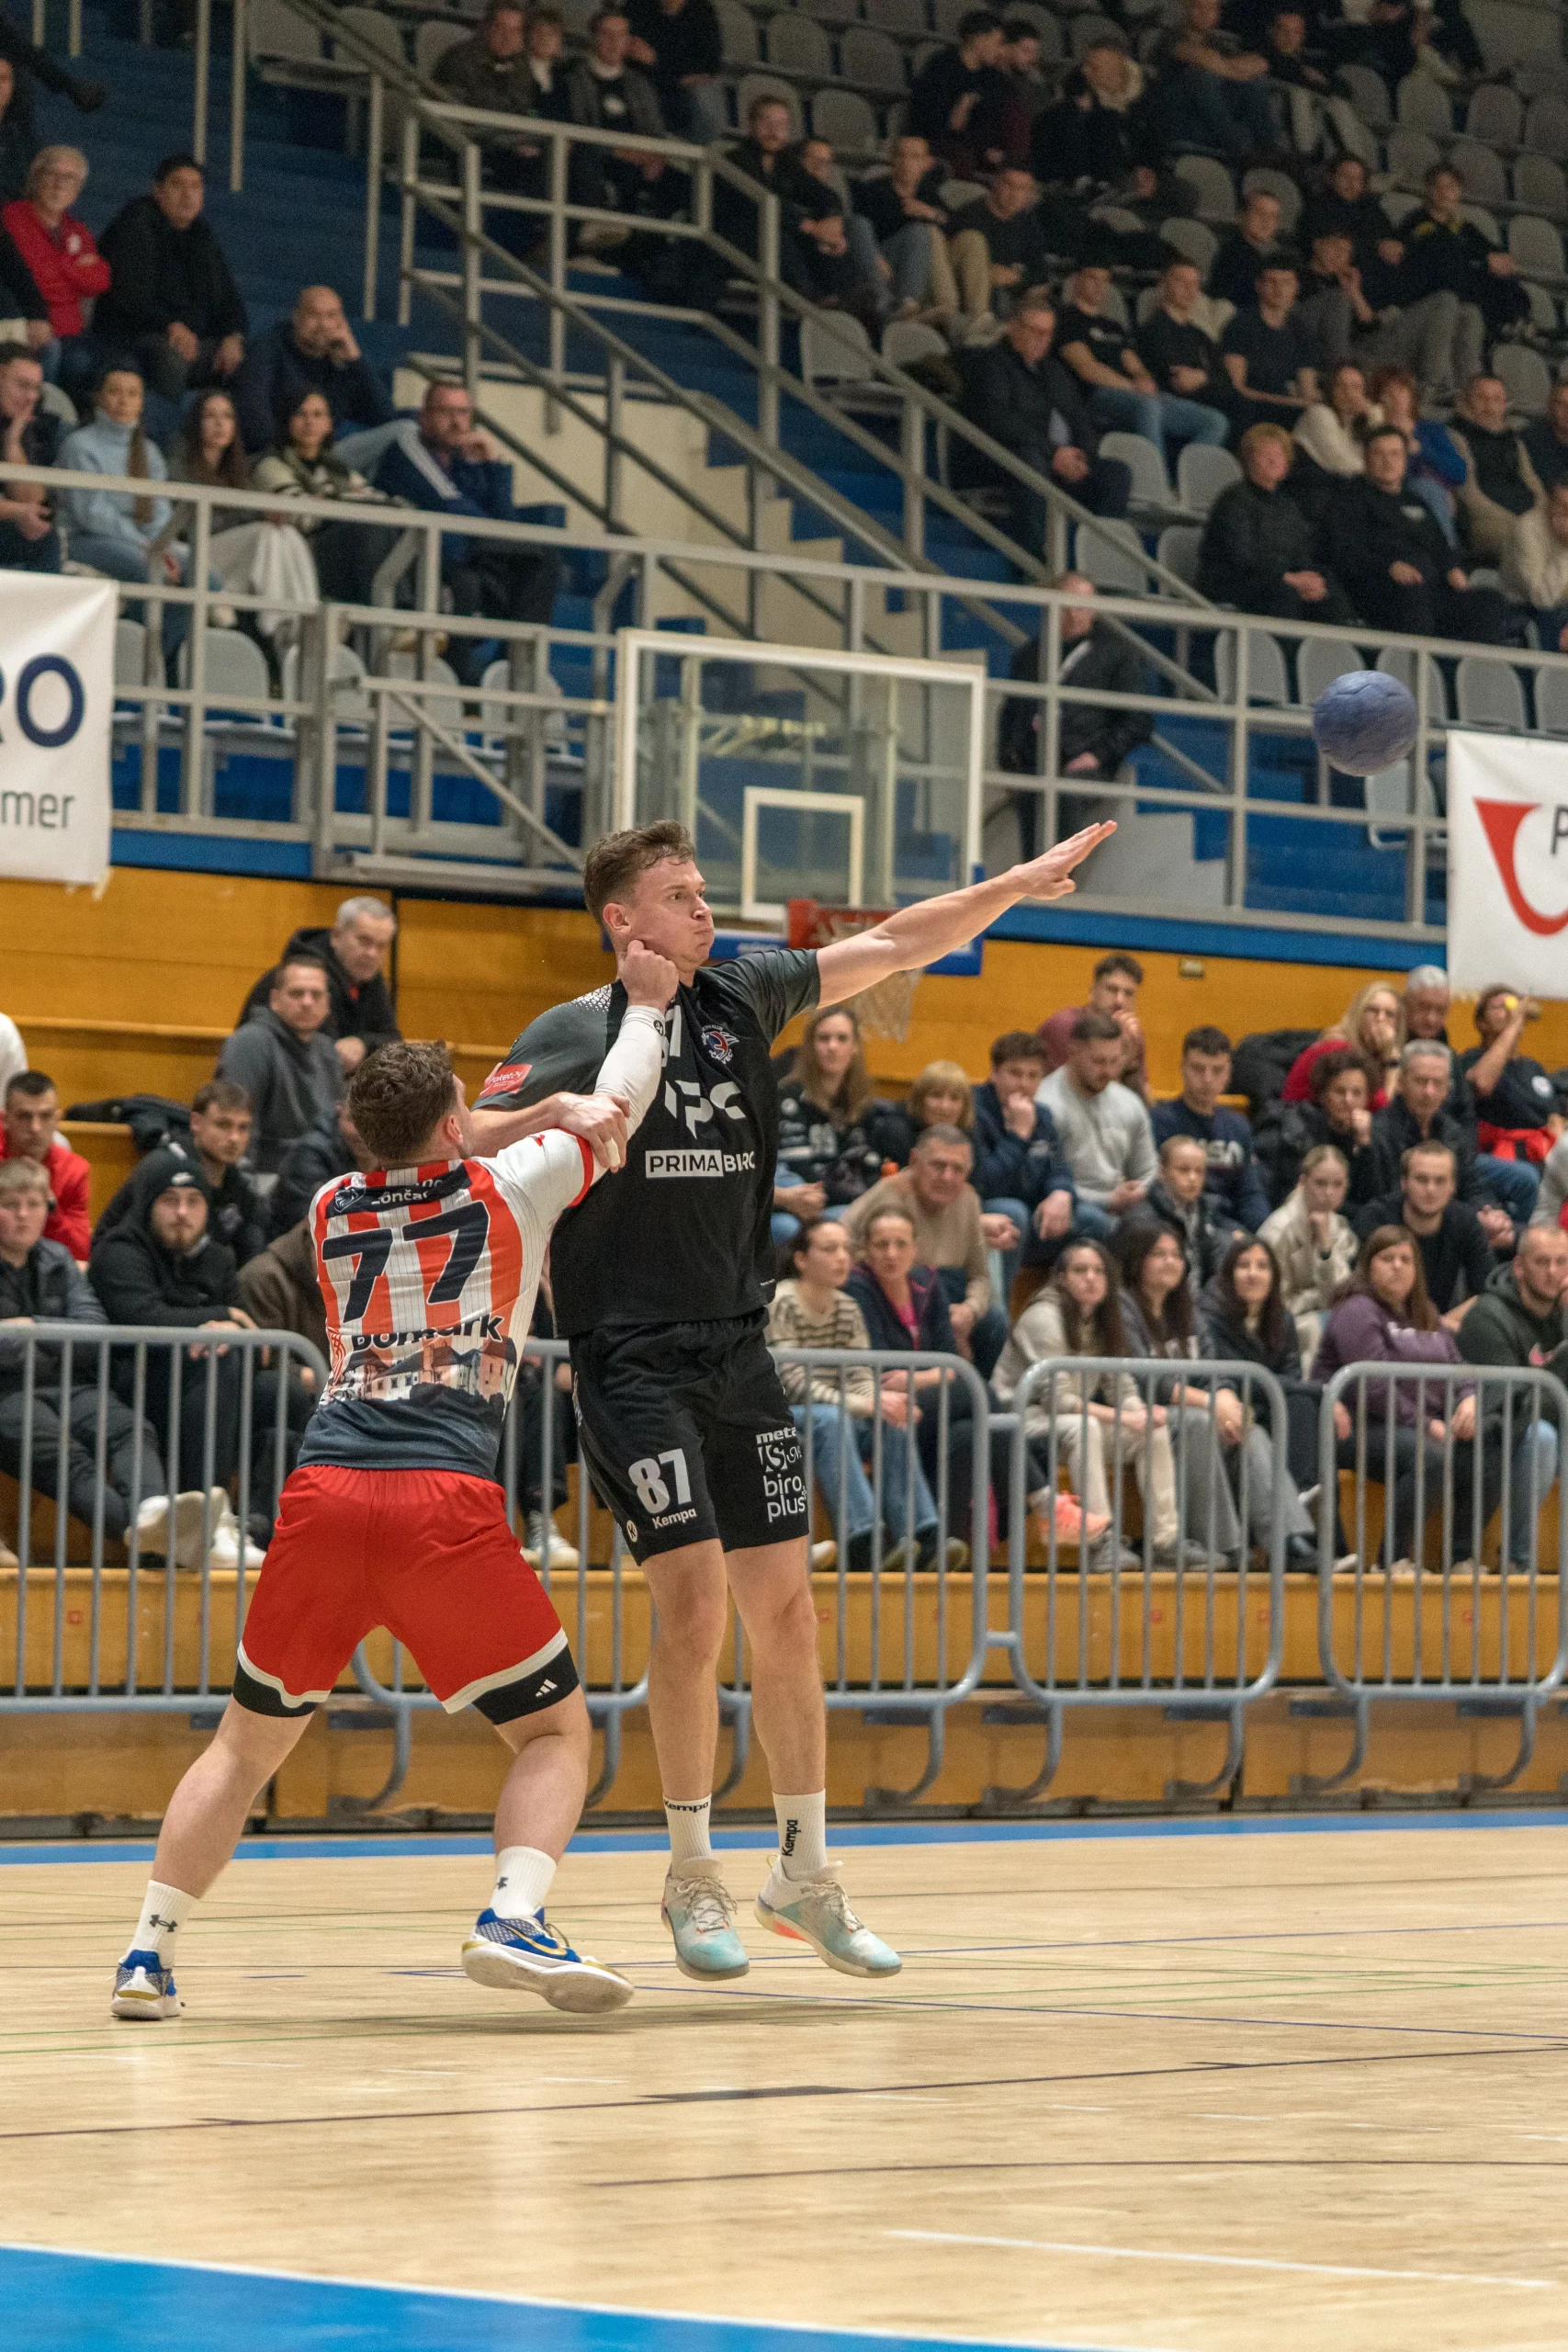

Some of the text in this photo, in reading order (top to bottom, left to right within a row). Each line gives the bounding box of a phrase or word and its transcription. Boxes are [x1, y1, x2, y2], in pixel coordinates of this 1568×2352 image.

[0, 653, 85, 747] O
[371, 1189, 429, 1205] ončar
[321, 1199, 491, 1323] 77
[628, 1448, 692, 1514] 87
[762, 1473, 802, 1497] biro
[651, 1509, 697, 1530] Kempa
[767, 1494, 806, 1522] plus
[663, 1799, 709, 1813] Kempa
[782, 1819, 801, 1857] Kempa
